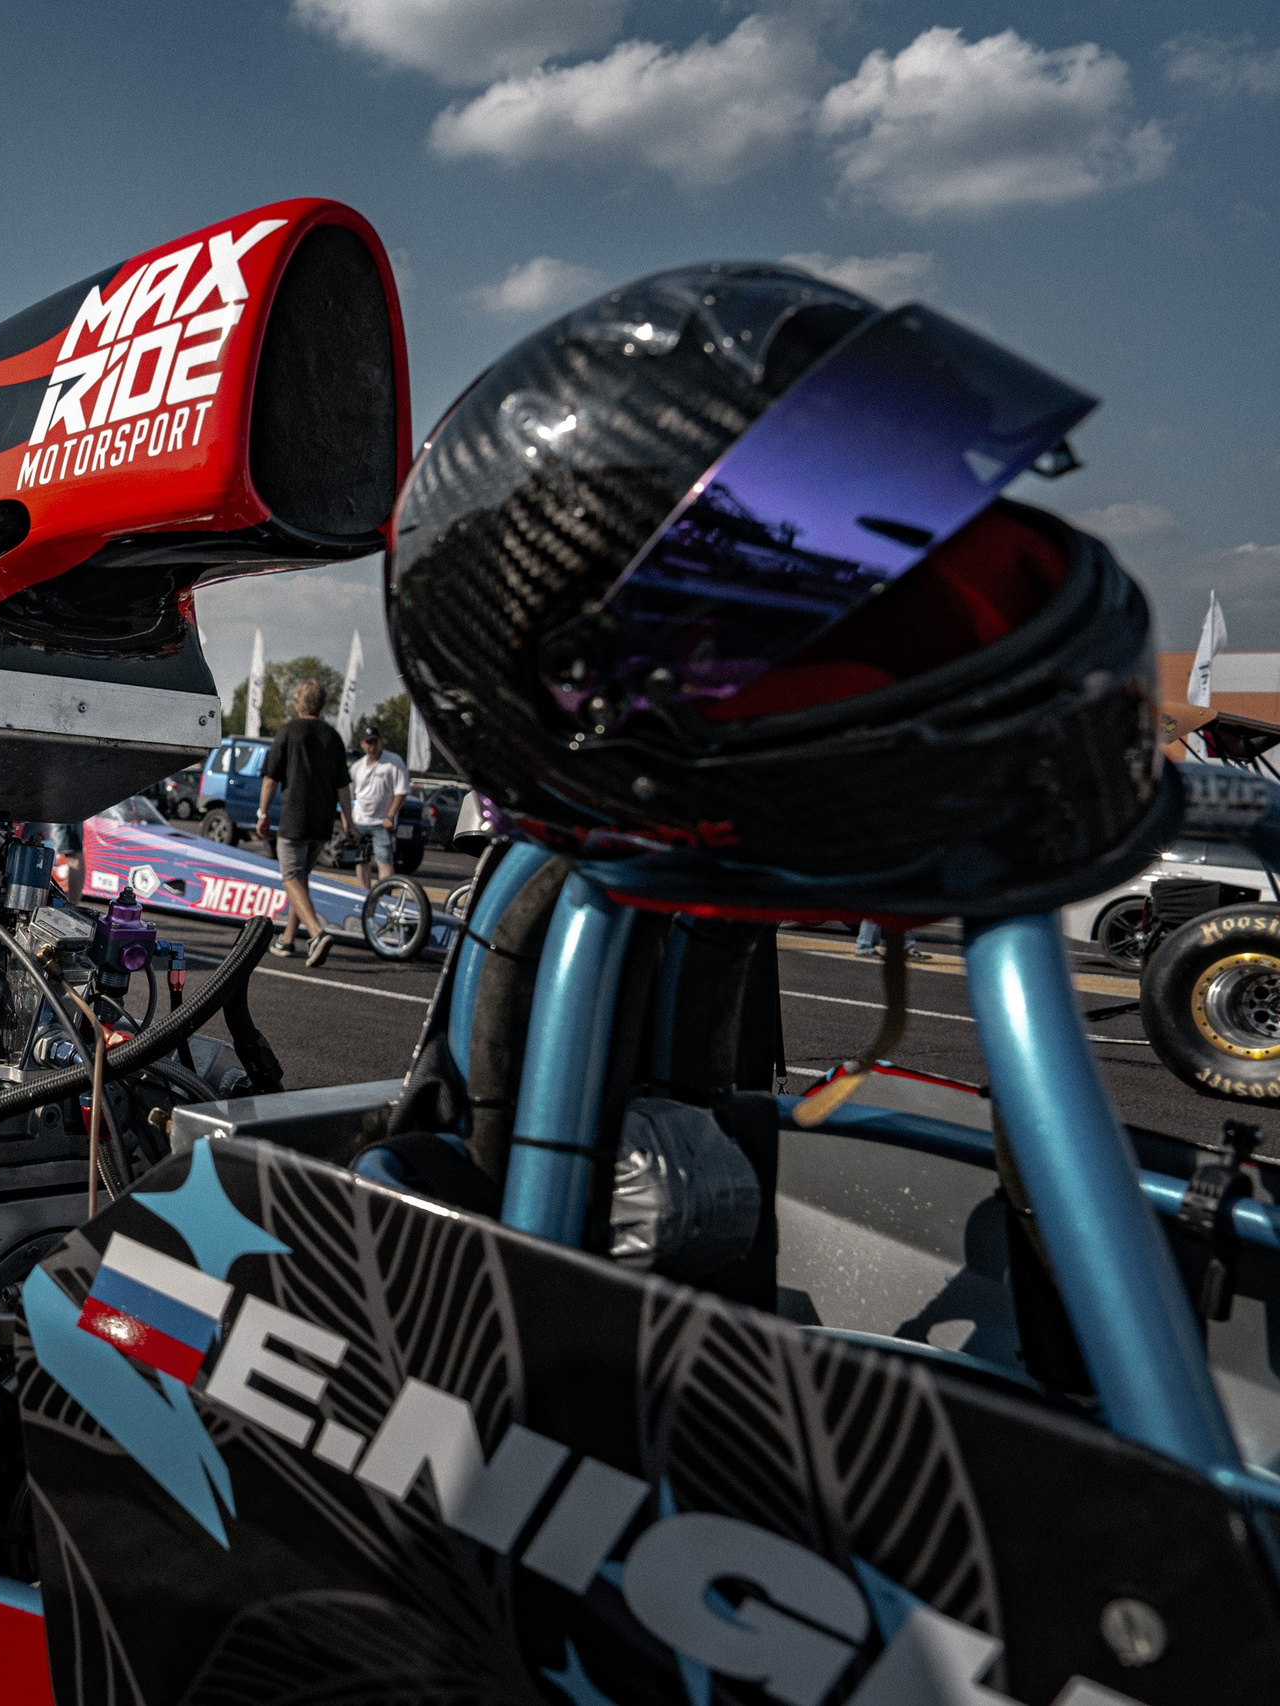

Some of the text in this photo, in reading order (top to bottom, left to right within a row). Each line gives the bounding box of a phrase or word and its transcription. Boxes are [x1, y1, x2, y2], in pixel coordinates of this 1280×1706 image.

[56, 220, 289, 363] MAX
[16, 400, 214, 492] MOTORSPORT
[1200, 915, 1280, 947] HOOSI
